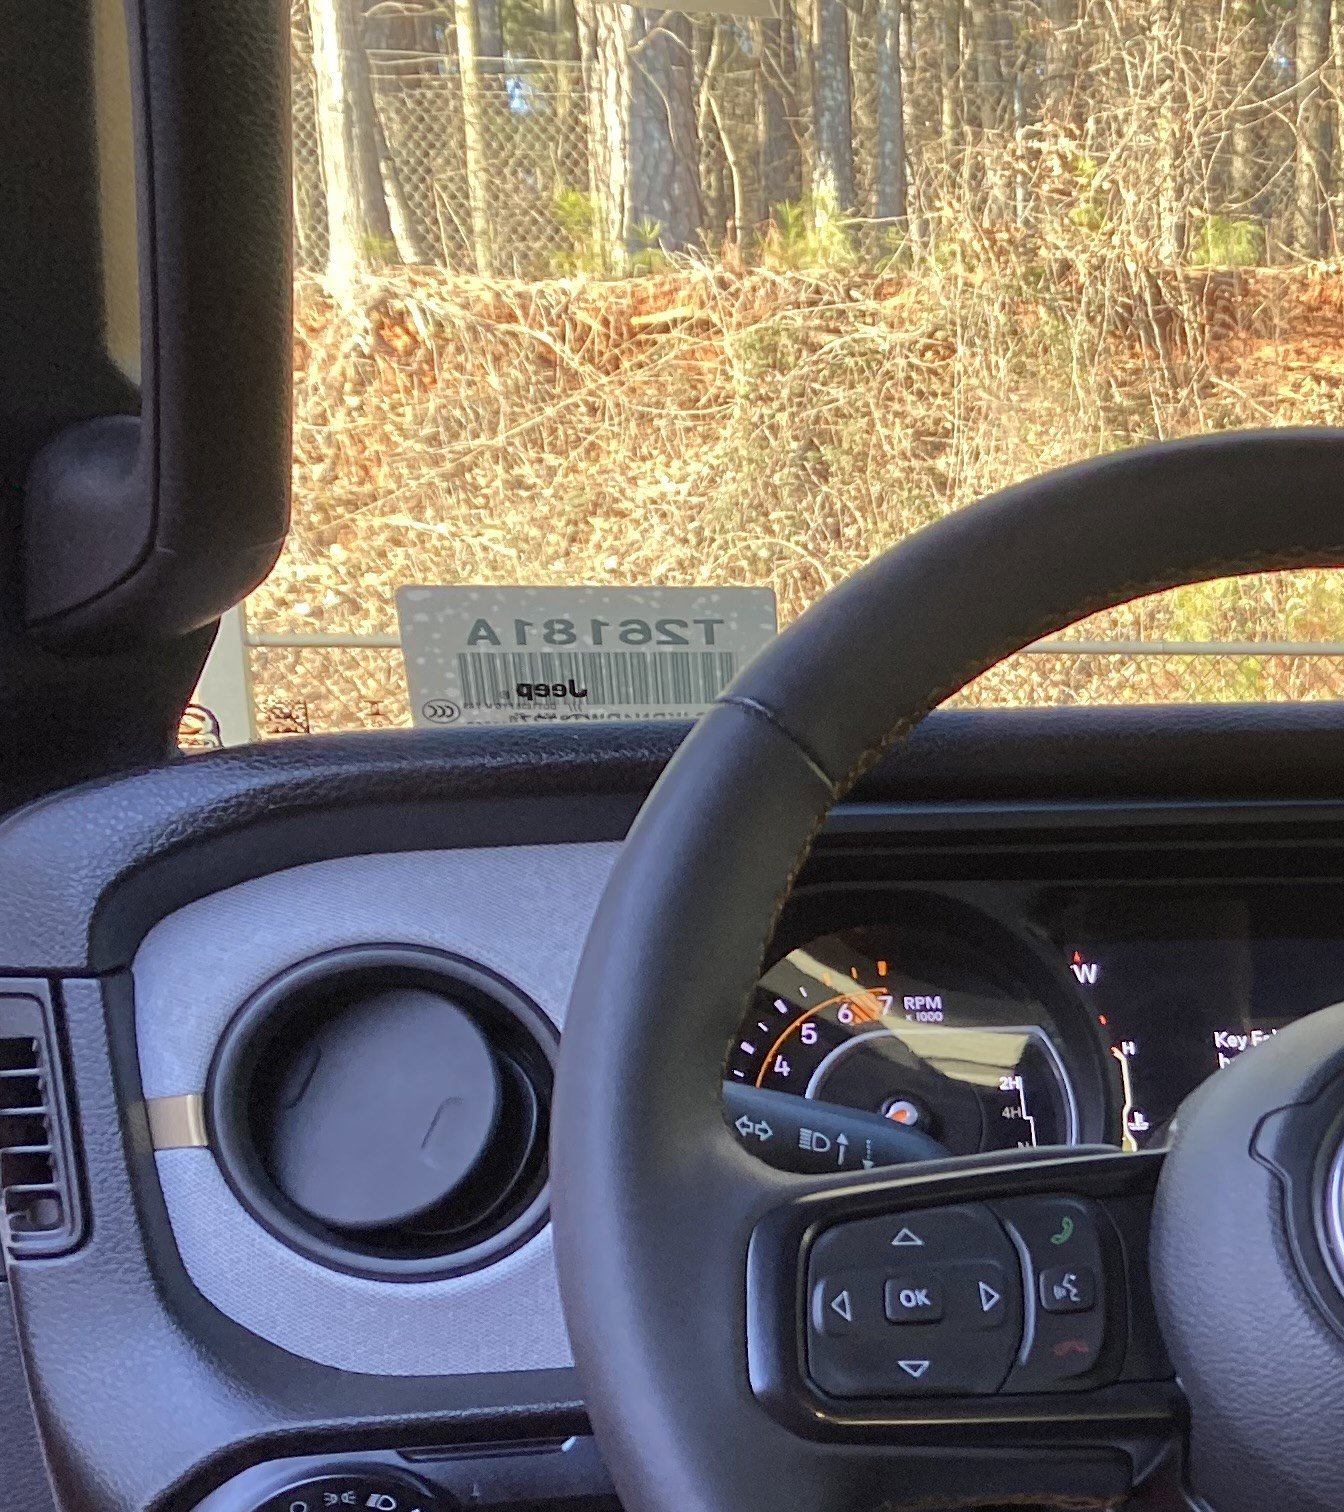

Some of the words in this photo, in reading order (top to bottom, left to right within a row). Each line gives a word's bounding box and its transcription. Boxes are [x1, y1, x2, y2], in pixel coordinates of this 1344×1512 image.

[876, 995, 893, 1016] 7
[903, 995, 943, 1011] RPM
[837, 1003, 854, 1024] 6
[916, 1012, 943, 1022] 1000
[801, 1023, 818, 1045] 5
[1213, 1030, 1248, 1051] Key
[1121, 1041, 1136, 1056] H
[774, 1055, 790, 1077] 4
[1001, 1106, 1021, 1119] 4H
[899, 1288, 931, 1308] OK
